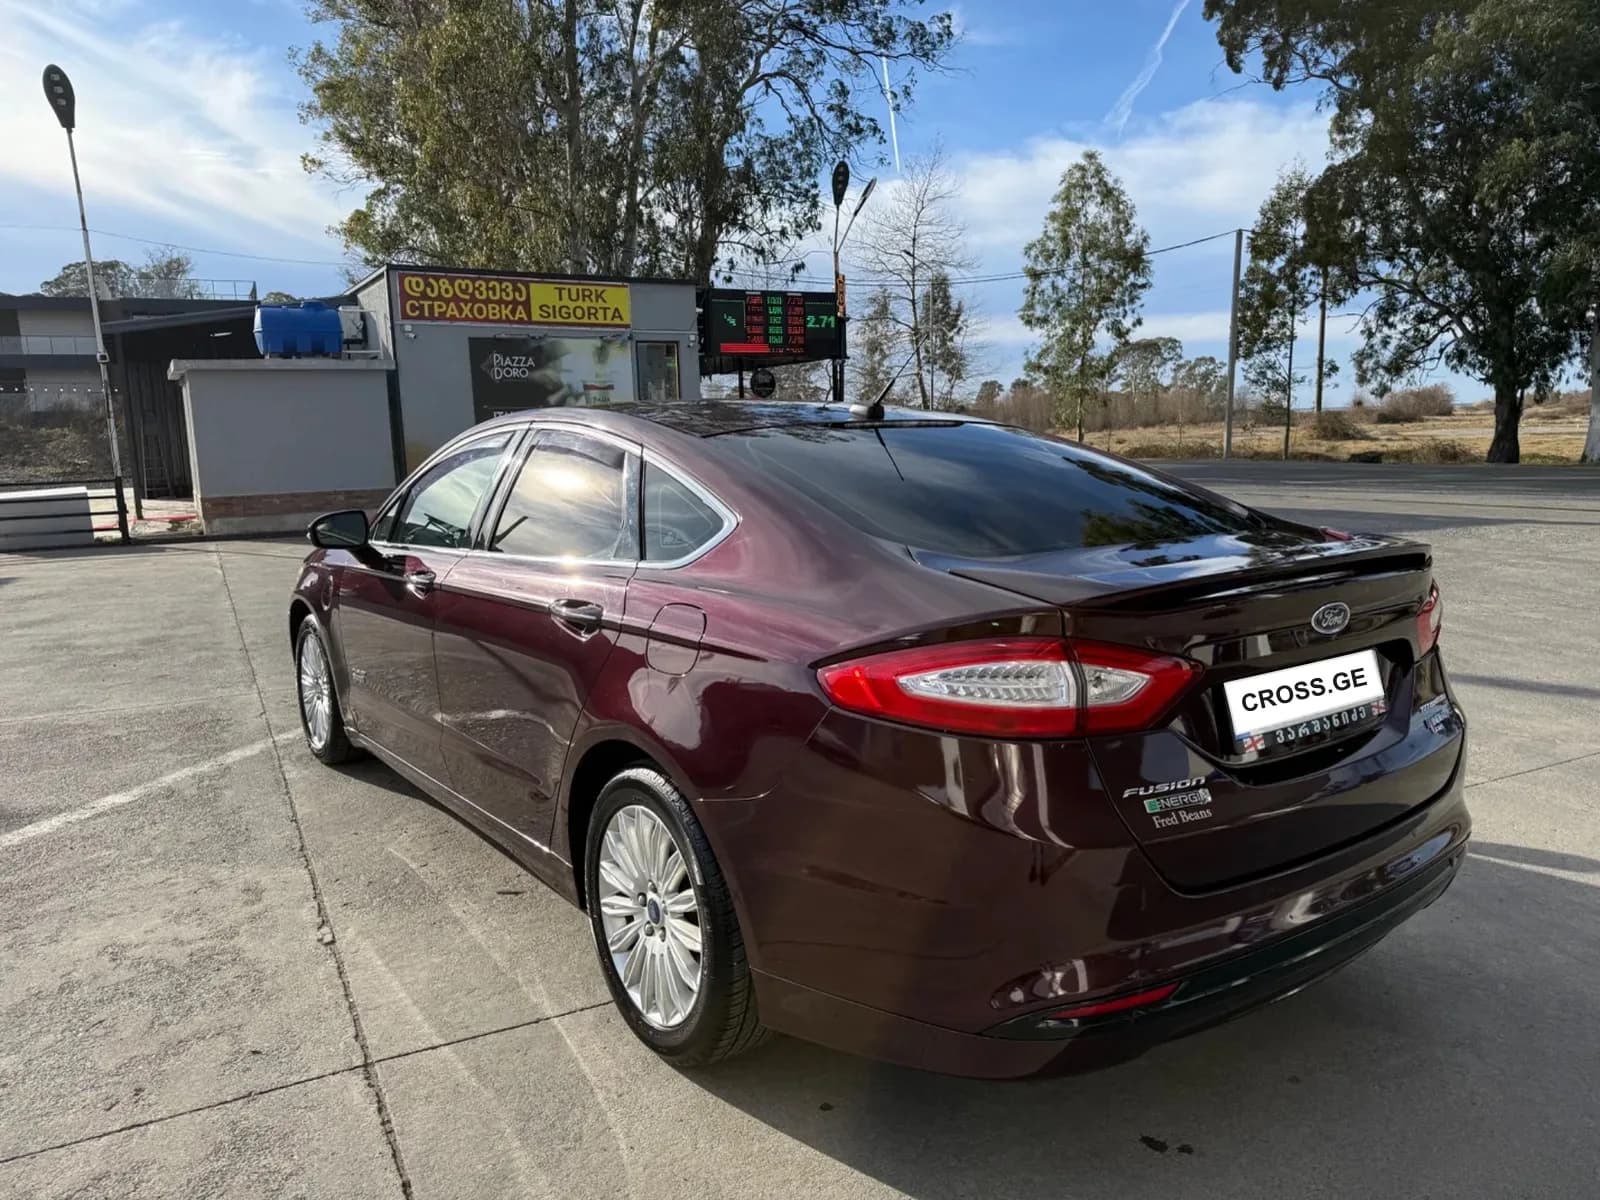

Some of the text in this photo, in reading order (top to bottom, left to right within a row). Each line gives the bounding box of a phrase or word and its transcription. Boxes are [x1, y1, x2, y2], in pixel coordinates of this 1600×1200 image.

[403, 276, 527, 302] დაზღვევა
[554, 286, 608, 304] TURK
[405, 300, 529, 321] СТРАХОВКА
[538, 304, 625, 322] SIGORTA
[493, 350, 536, 367] PIAZZA
[1319, 608, 1346, 628] Ford
[1122, 776, 1206, 799] FUSION
[1152, 808, 1213, 829] Fred Beans
